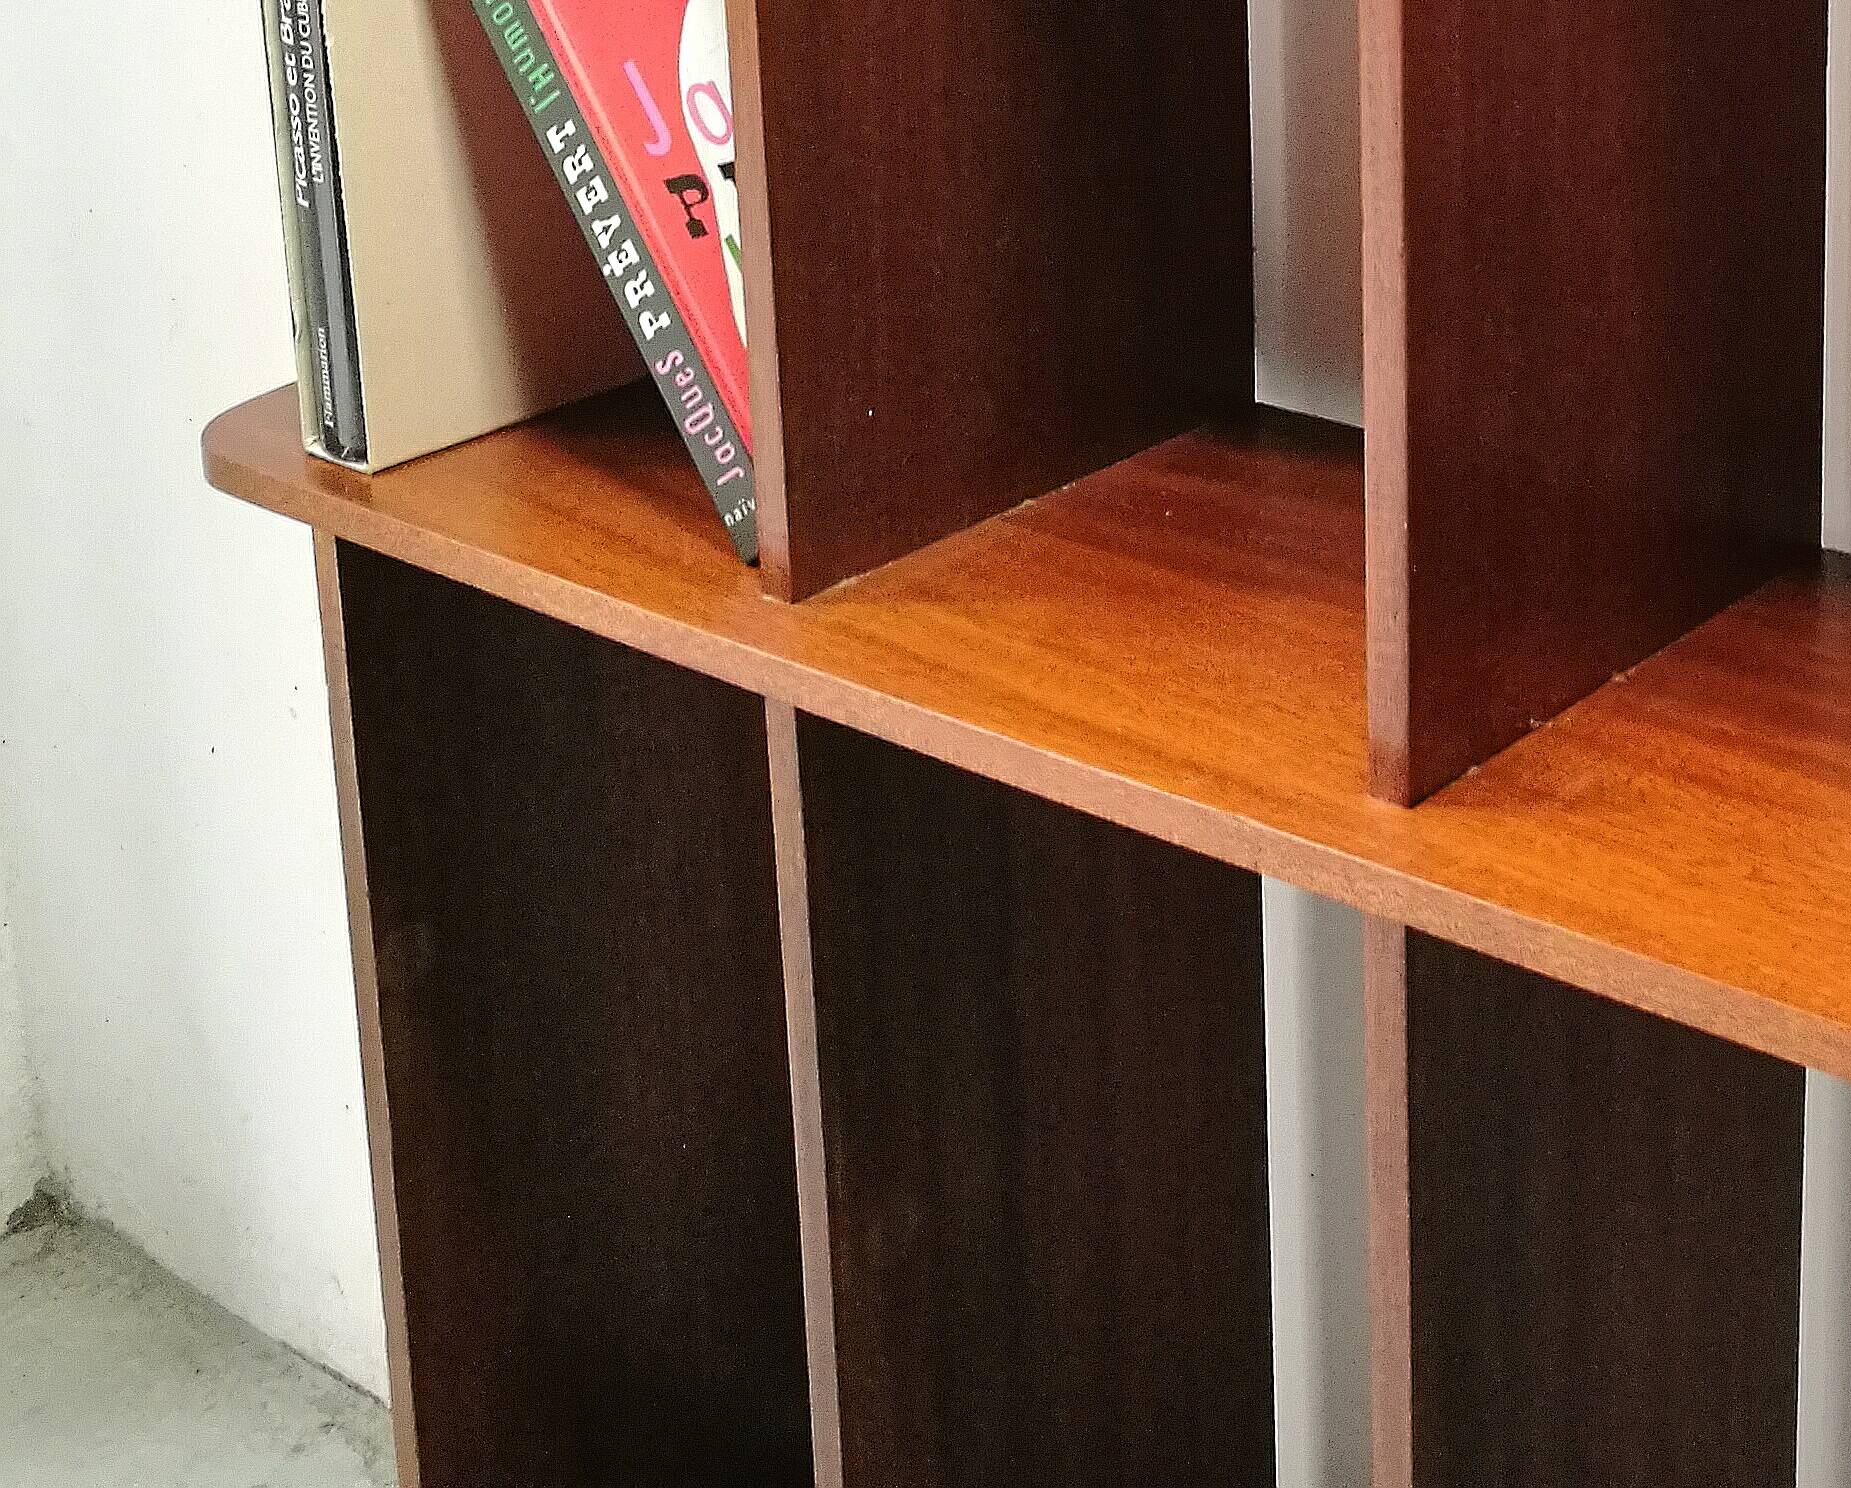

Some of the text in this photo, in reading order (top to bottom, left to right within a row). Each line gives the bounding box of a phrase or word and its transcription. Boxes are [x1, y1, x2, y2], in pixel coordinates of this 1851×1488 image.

[284, 50, 298, 87] et
[301, 37, 314, 70] DU
[288, 92, 310, 209] Picasso
[303, 72, 325, 184] L'INVENTION
[318, 327, 334, 428] Flammarion
